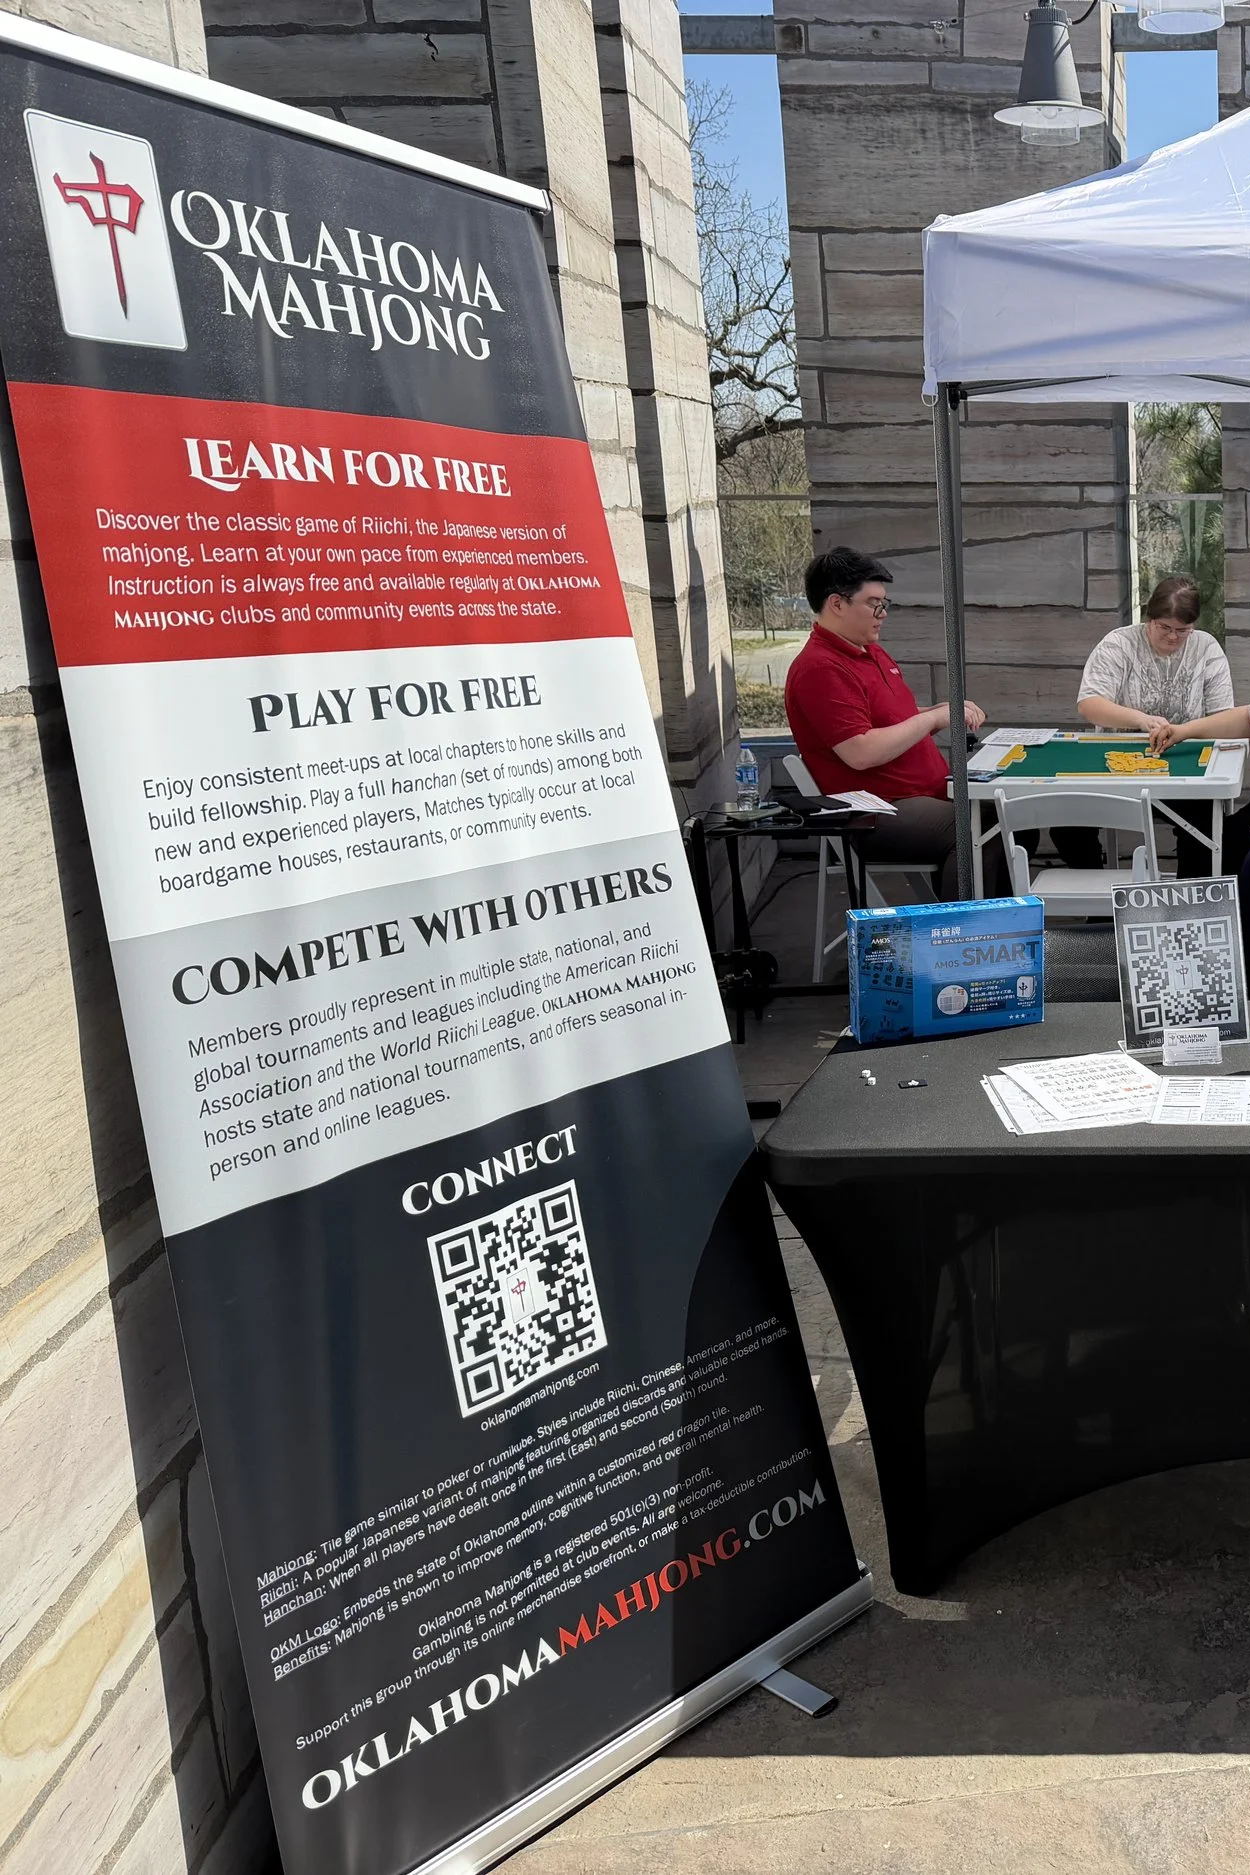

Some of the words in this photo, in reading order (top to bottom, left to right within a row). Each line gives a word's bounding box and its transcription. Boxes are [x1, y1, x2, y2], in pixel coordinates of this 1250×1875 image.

[170, 189, 506, 313] OKLAHOMA
[202, 251, 491, 361] MAHJONG
[182, 437, 335, 492] LEARN
[342, 449, 432, 489] FOR
[432, 456, 512, 497] FREE
[95, 508, 181, 531] Discover
[185, 511, 220, 532] the
[226, 512, 292, 532] classic
[295, 516, 339, 537] game
[342, 515, 357, 534] of
[362, 516, 413, 537] Riichi,
[415, 518, 439, 536] the
[442, 519, 498, 540] Japanese
[498, 524, 549, 541] version
[552, 524, 567, 540] of
[102, 542, 195, 568] mahjong.
[200, 543, 259, 563] Learn
[265, 544, 286, 562] at
[287, 547, 322, 566] your
[326, 548, 356, 562] own
[360, 548, 402, 566] pace
[404, 544, 439, 563] from
[442, 548, 514, 567] experienced
[516, 549, 589, 566] members.
[107, 574, 214, 596] Instruction
[220, 574, 237, 594] is
[242, 573, 305, 596] always
[308, 572, 340, 592] free
[342, 573, 375, 592] and
[379, 572, 446, 591] available
[449, 574, 499, 594] regularly
[501, 575, 516, 591] at
[517, 576, 601, 591] OKLAHOMA
[114, 609, 215, 631] MAHJONG
[220, 604, 276, 625] clubs
[281, 602, 312, 622] and
[315, 601, 404, 622] community
[408, 601, 455, 618] events
[458, 603, 496, 617] across
[496, 600, 519, 617] the
[520, 600, 562, 616] state.
[248, 687, 356, 733] PLAY
[366, 681, 456, 721] FOR
[459, 674, 542, 712] FREE
[142, 776, 194, 801] Enjoy
[200, 762, 304, 792] consistent
[307, 755, 380, 778] meet-ups
[385, 750, 405, 768] at
[408, 744, 443, 764] local
[445, 740, 506, 760] chapters
[505, 738, 517, 752] to
[518, 735, 554, 750] hone
[556, 727, 596, 746] skills
[598, 723, 626, 741] and
[148, 806, 196, 831] build
[200, 793, 306, 823] fellowship.
[310, 788, 340, 808] Play
[344, 787, 354, 802] a
[357, 779, 386, 800] full
[392, 772, 457, 795] hanchan
[460, 766, 491, 788] (set
[493, 762, 505, 780] of
[507, 757, 554, 778] rounds)
[556, 751, 611, 771] among
[611, 746, 643, 763] both
[154, 842, 192, 862] new
[198, 831, 236, 855] and
[242, 813, 348, 848] experienced
[352, 807, 420, 833] players,
[424, 796, 485, 818] Matches
[487, 786, 535, 810] typically
[538, 782, 577, 799] occur
[581, 777, 599, 793] at
[600, 770, 636, 790] local
[172, 919, 405, 1006] COMPETE
[409, 894, 520, 948] WITH
[525, 862, 672, 921] OTHERS
[1114, 884, 1236, 910] CONNECT
[188, 1022, 283, 1058] Members
[288, 1001, 347, 1036] proudly
[351, 978, 437, 1013] represent
[440, 974, 456, 991] in
[459, 958, 515, 986] multiple
[518, 950, 552, 969] state,
[554, 930, 619, 958] national,
[622, 921, 652, 942] and
[934, 959, 960, 969] AMOS
[962, 940, 1040, 967] SMART
[194, 1055, 251, 1093] global
[255, 1026, 369, 1070] tournaments
[372, 1012, 407, 1036] and
[411, 997, 475, 1026] leagues
[476, 979, 541, 1008] including
[540, 972, 563, 990] the
[565, 953, 636, 982] American
[640, 939, 679, 962] Riichi
[199, 1074, 312, 1119] Association
[316, 1058, 345, 1084] and
[347, 1052, 376, 1072] the
[380, 1033, 431, 1062] World
[437, 1019, 479, 1047] Riichi
[481, 1006, 540, 1033] League.
[542, 982, 623, 1014] OKLAHOMA
[626, 961, 696, 991] MAHJONG
[402, 1124, 577, 1215] CONNECT
[319, 1537, 342, 1555] Tile
[344, 1516, 375, 1544] game
[377, 1494, 419, 1522] similar
[421, 1487, 434, 1500] to
[436, 1468, 470, 1495] poker
[472, 1462, 485, 1475] or
[536, 1416, 568, 1439] Styles
[568, 1397, 606, 1422] include
[735, 1326, 753, 1343] and
[418, 1596, 482, 1637] Oklahoma
[484, 1562, 534, 1601] Mahjong
[532, 1559, 544, 1571] is
[544, 1553, 552, 1564] a
[554, 1519, 608, 1558] registered
